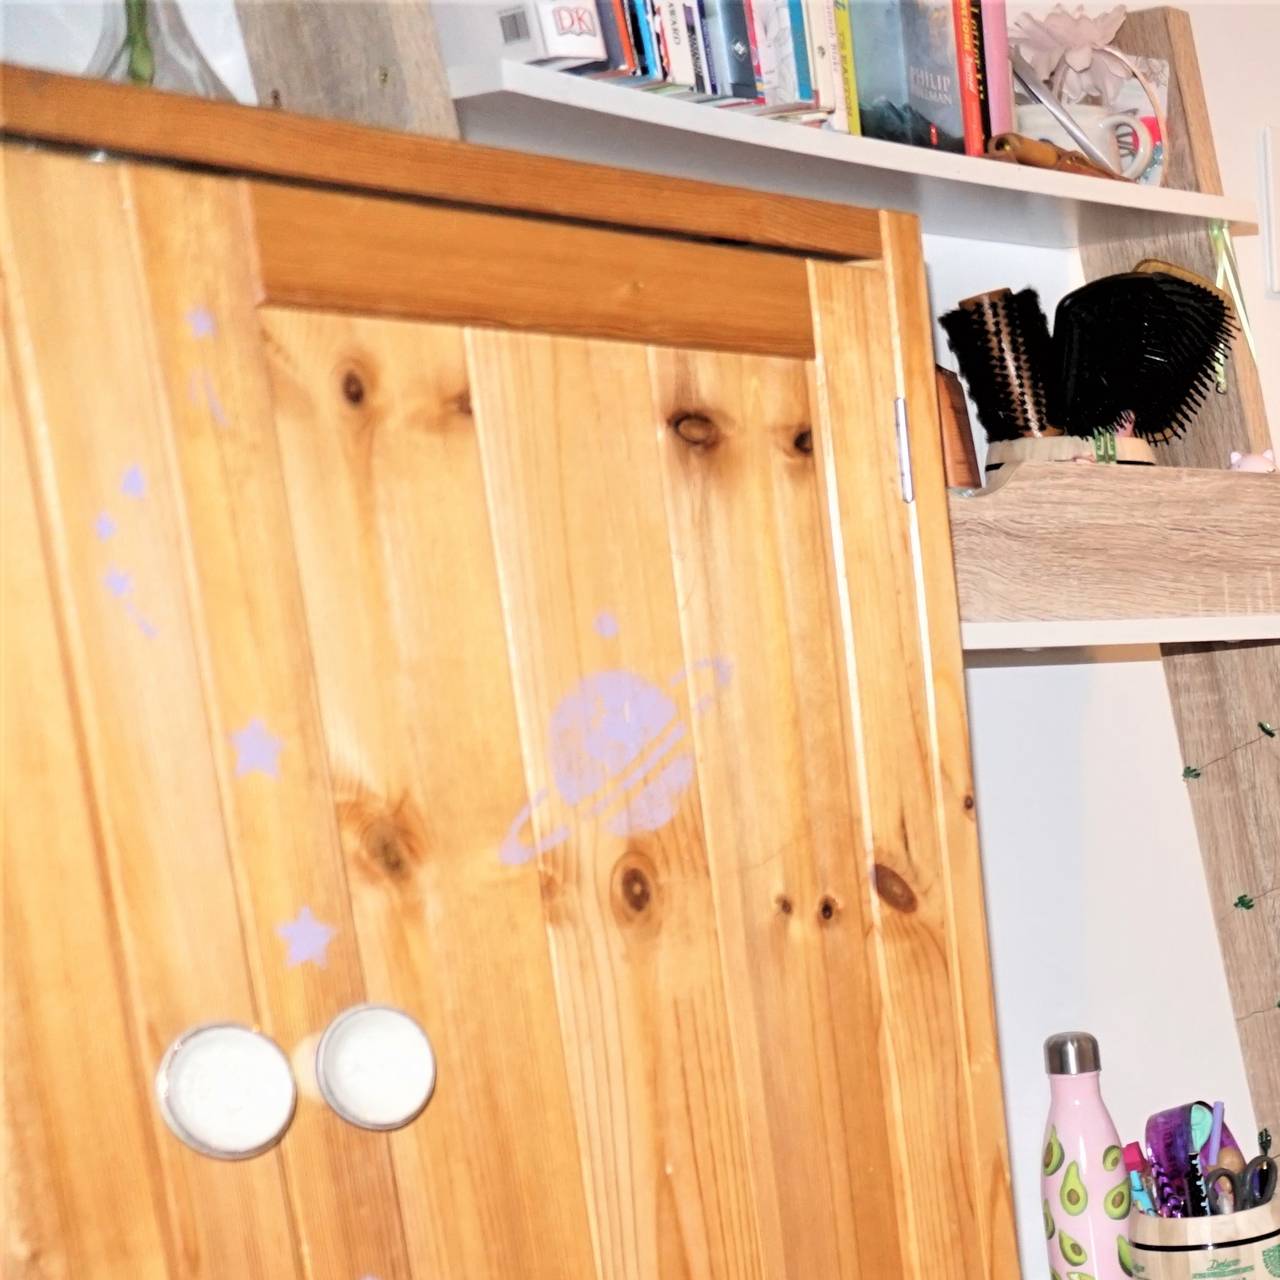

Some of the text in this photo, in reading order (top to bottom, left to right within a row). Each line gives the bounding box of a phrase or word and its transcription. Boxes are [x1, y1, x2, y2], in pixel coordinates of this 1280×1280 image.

[556, 6, 594, 34] DK
[667, 3, 681, 45] AWARD
[960, 0, 972, 51] WESOME
[909, 65, 951, 92] PHILIP
